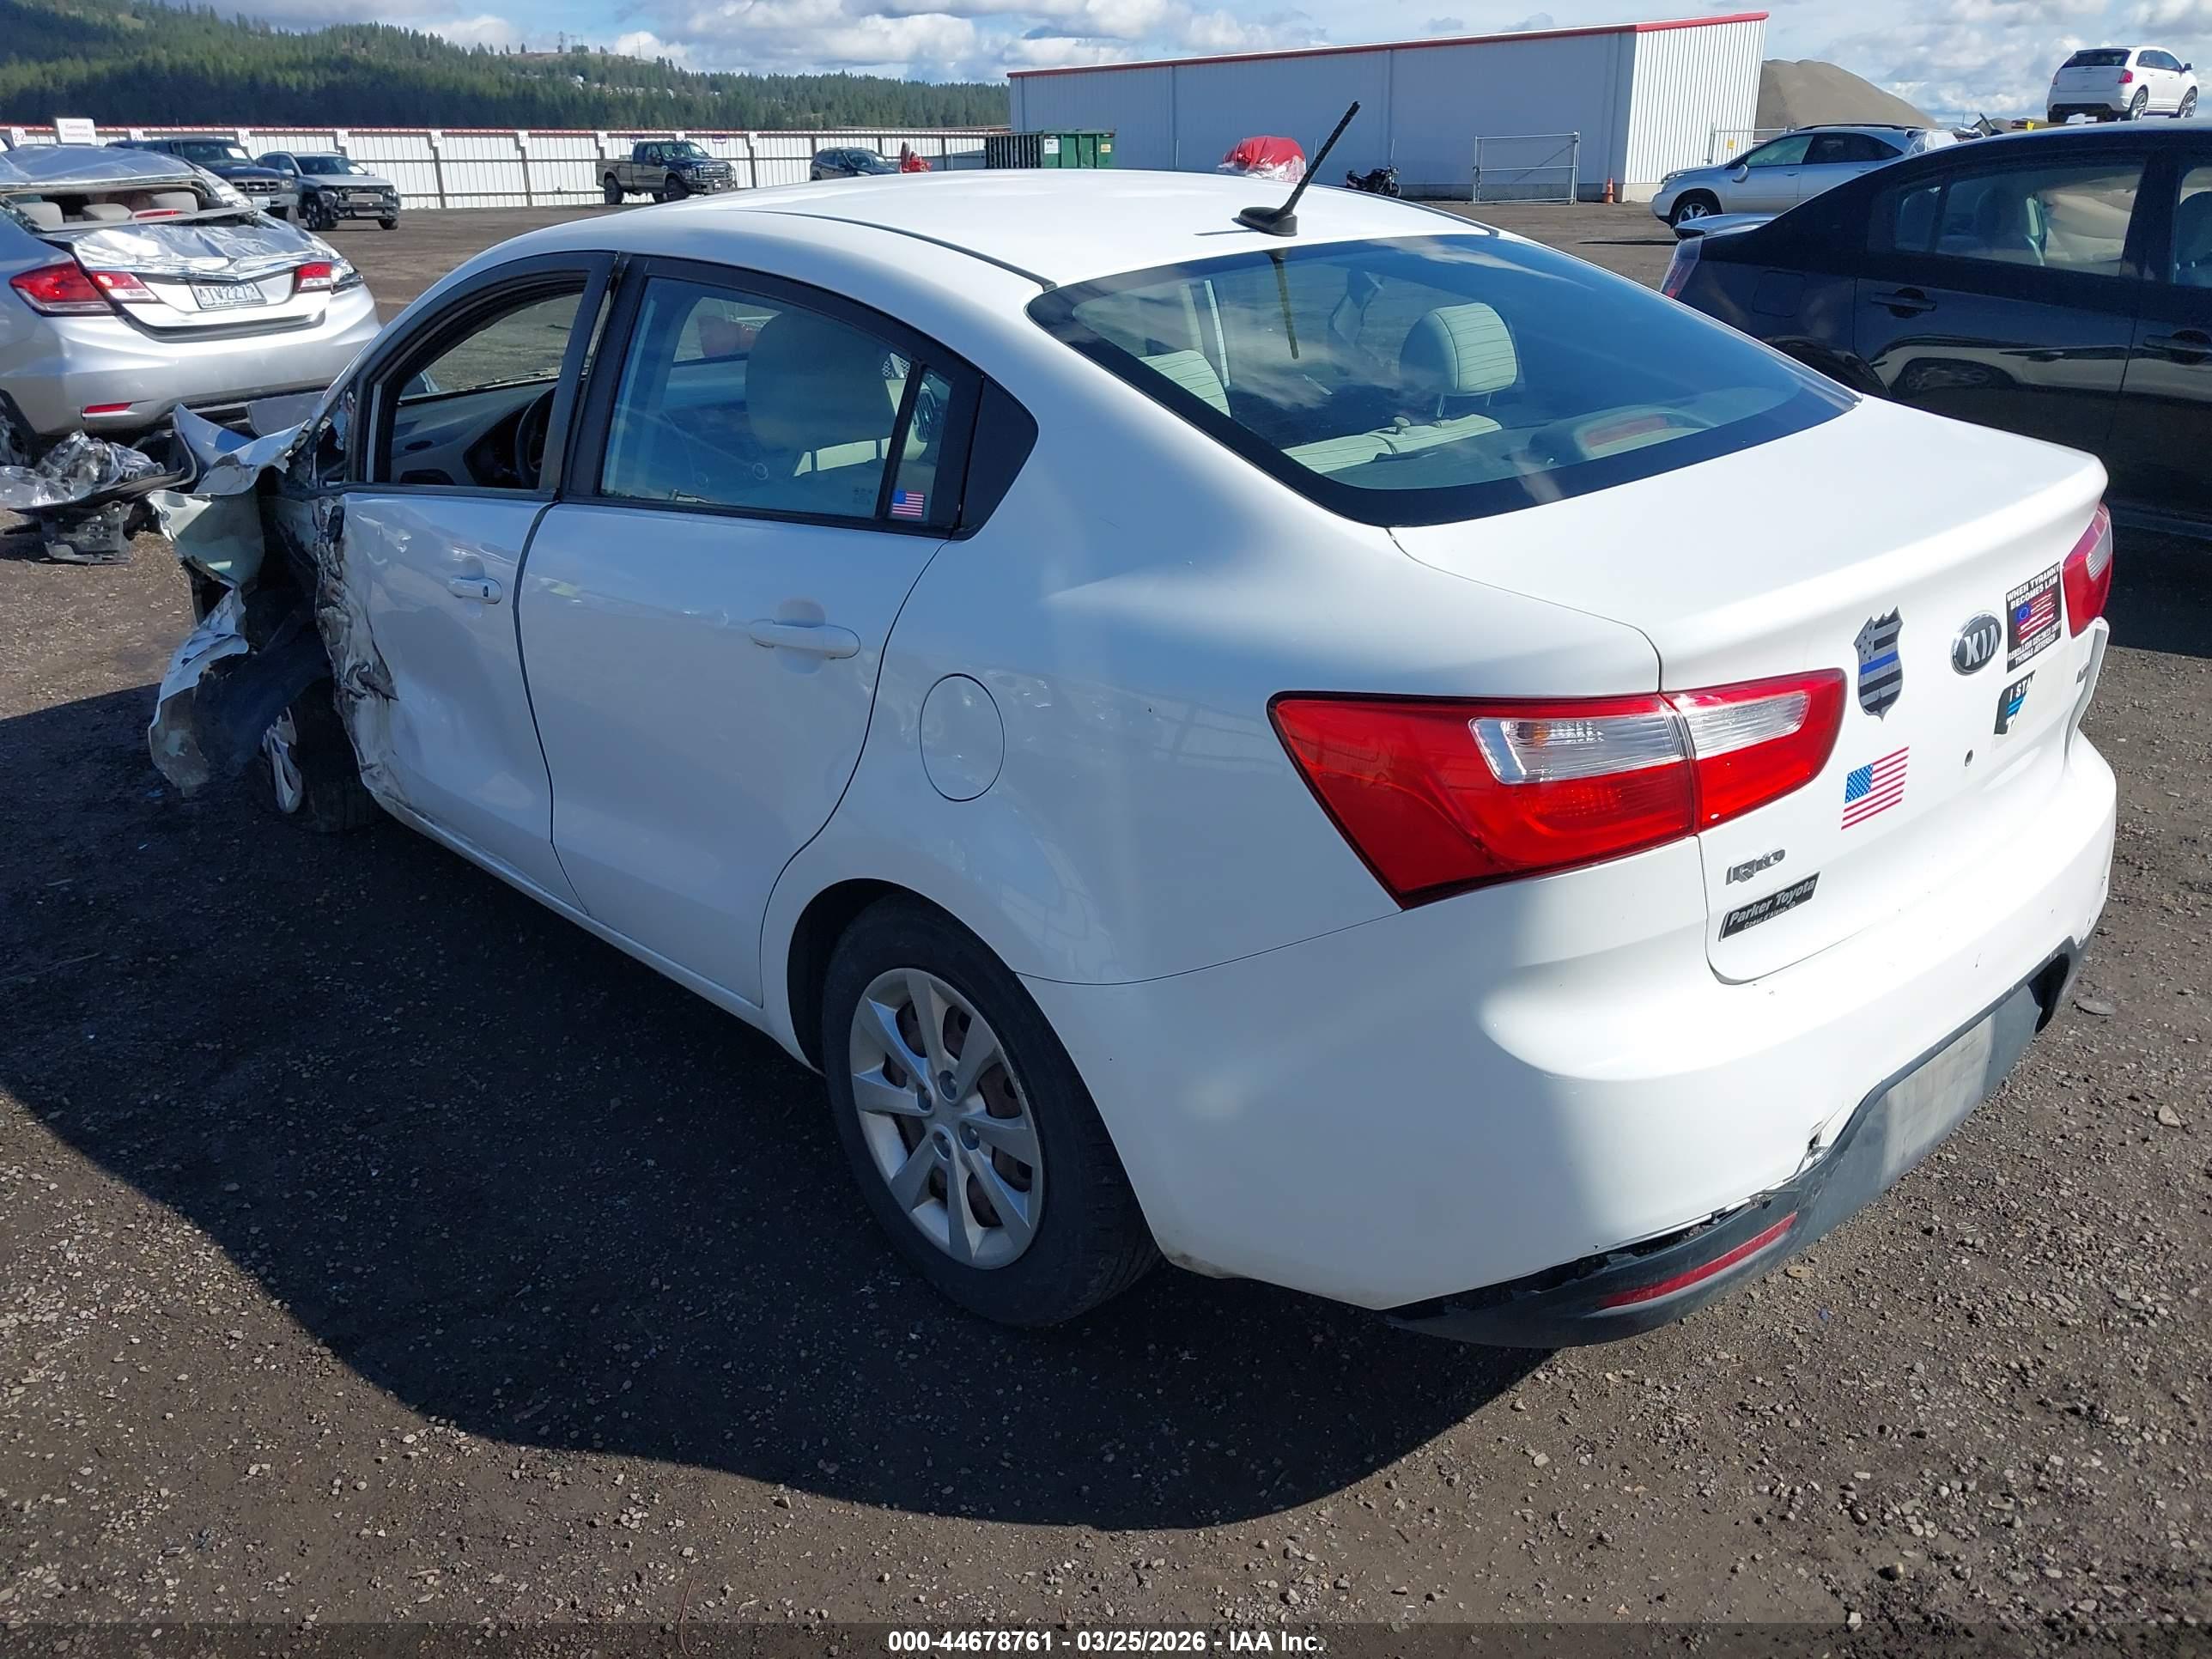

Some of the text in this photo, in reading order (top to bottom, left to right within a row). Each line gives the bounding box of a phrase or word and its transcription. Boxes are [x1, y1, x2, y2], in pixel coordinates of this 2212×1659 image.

[240, 133, 249, 142] 24
[338, 133, 348, 142] 25
[2007, 563, 2060, 602] WHEN TYRANNY
[2010, 574, 2058, 611] BECOMES LAW
[1965, 624, 2000, 667] KIA
[2015, 647, 2033, 665] THOMAS
[1729, 878, 1816, 927] Parker Toyota
